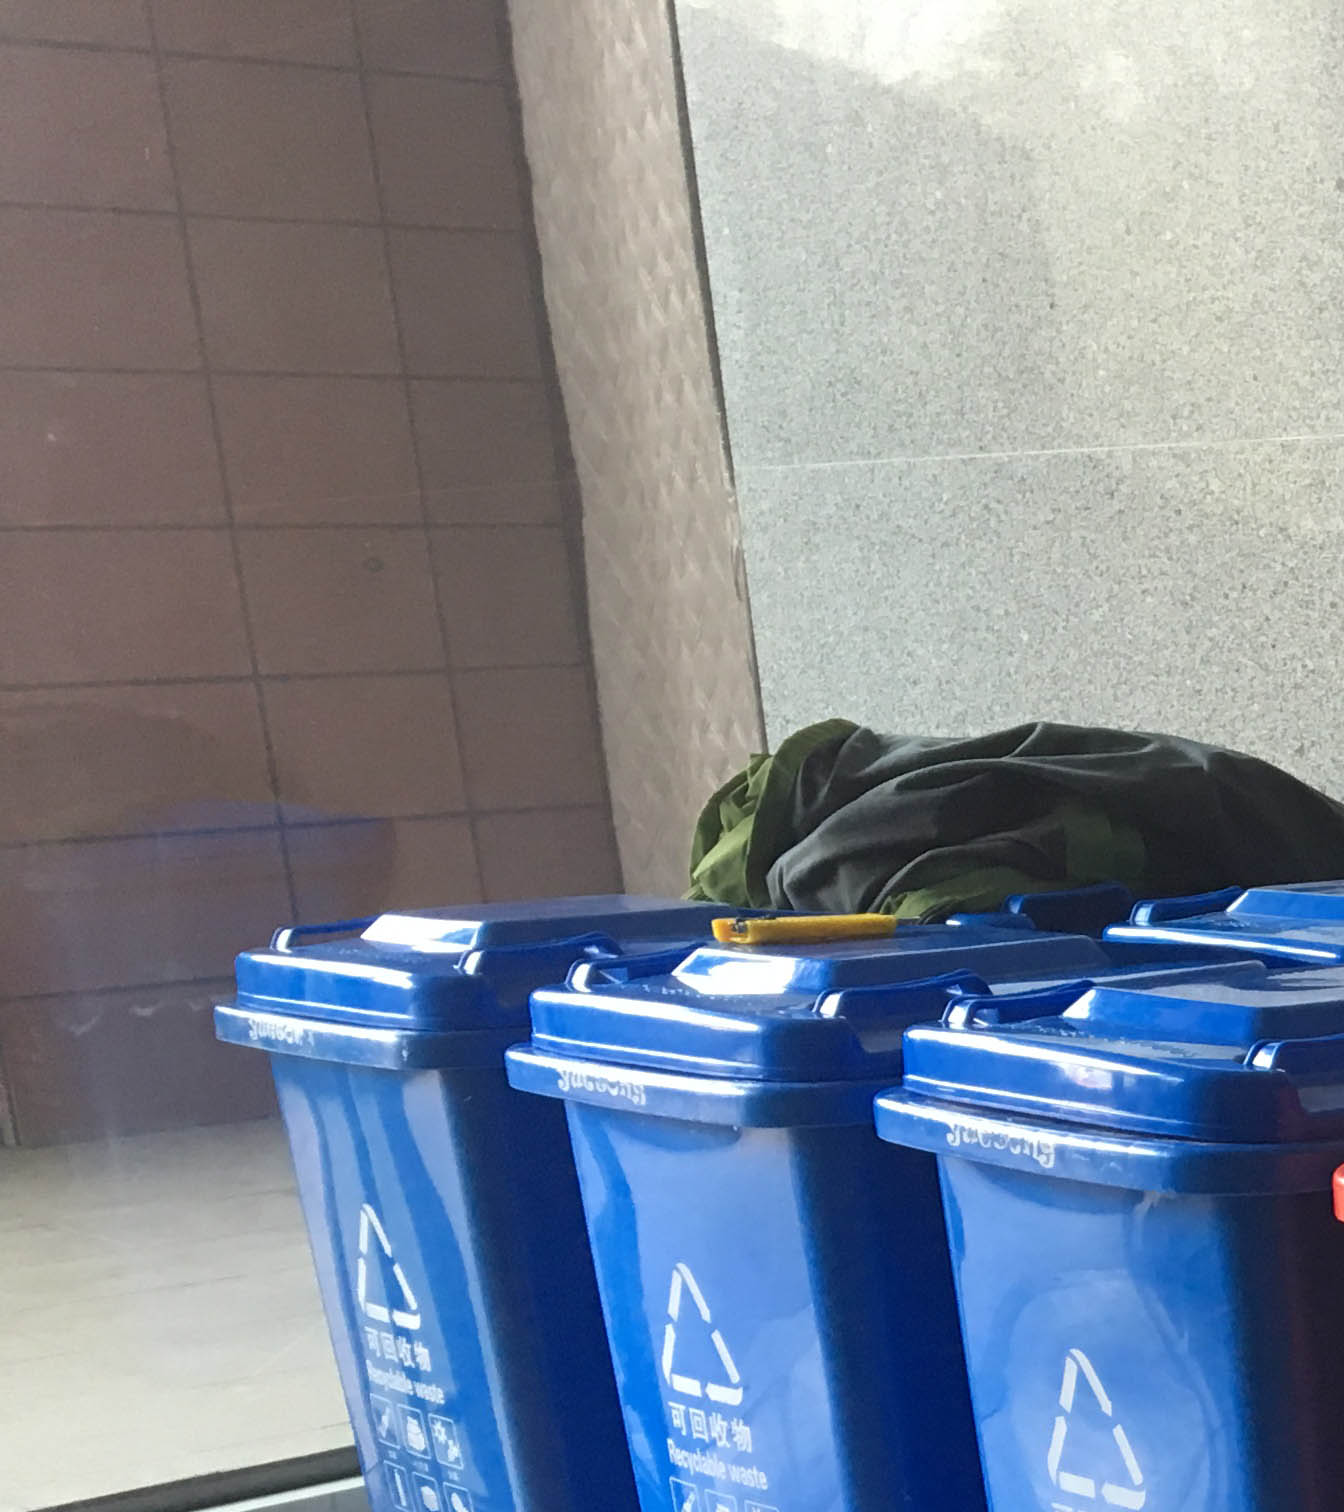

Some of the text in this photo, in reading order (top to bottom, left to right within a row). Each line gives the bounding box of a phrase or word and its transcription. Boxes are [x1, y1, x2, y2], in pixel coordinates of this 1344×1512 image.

[363, 1325, 432, 1373] 可回收物
[668, 1401, 753, 1454] 可回收物
[728, 1463, 768, 1491] waste
